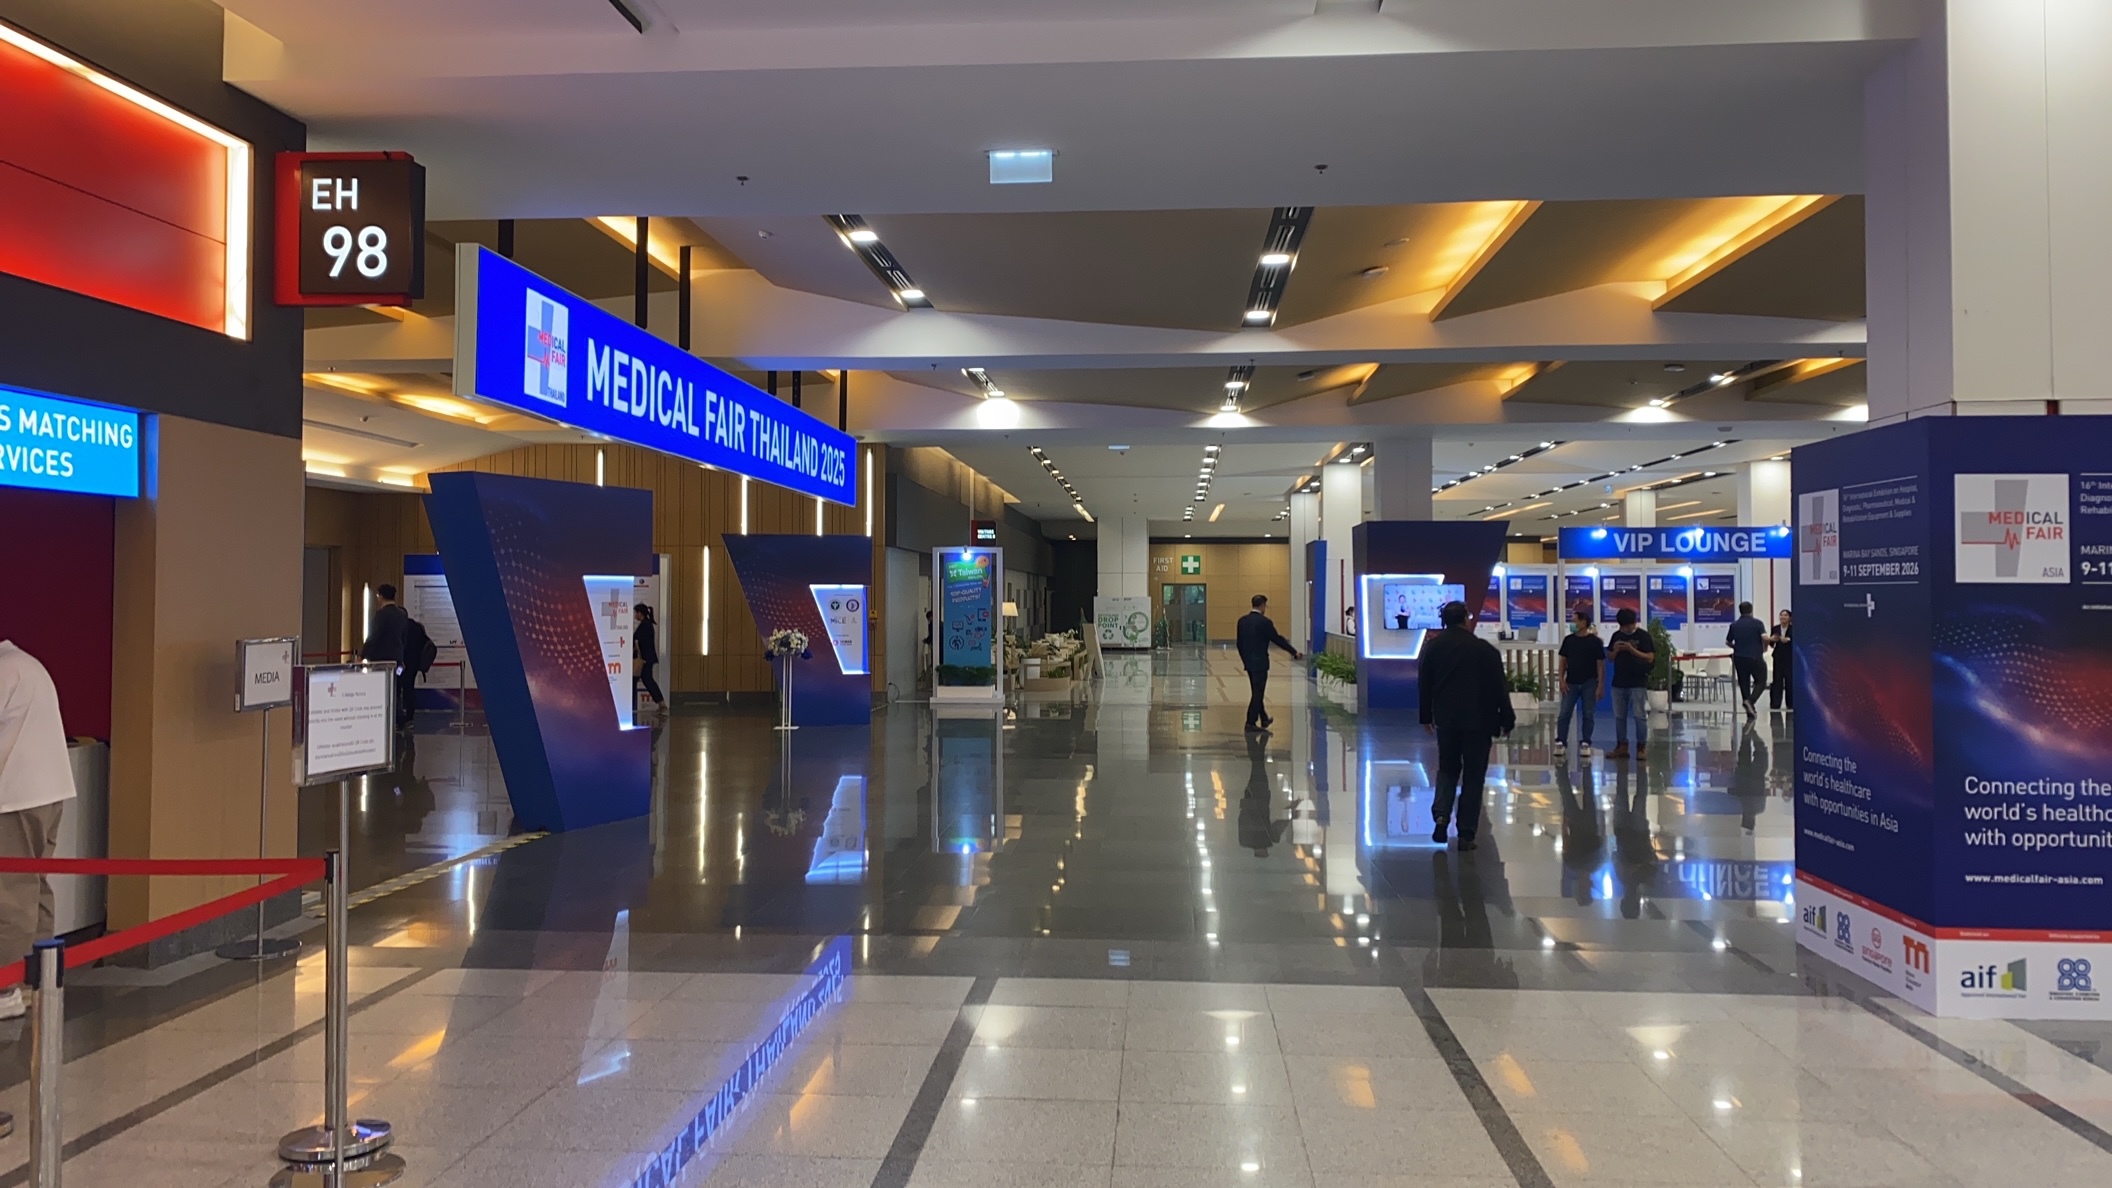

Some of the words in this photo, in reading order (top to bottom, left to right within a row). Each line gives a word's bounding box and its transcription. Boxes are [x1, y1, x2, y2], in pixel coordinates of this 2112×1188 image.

[312, 178, 358, 210] EH
[323, 225, 388, 278] 98
[538, 330, 566, 353] MEDICAL
[551, 350, 566, 367] FAIR
[587, 337, 700, 437] MEDICAL
[705, 389, 746, 453] FAIR
[749, 409, 819, 478] THAILAND
[820, 442, 846, 488] 2025
[19, 407, 133, 449] MATCHING
[1988, 511, 2064, 524] MEDICAL
[1614, 533, 1653, 552] VIP
[1661, 532, 1767, 553] LOUNGE
[1823, 535, 1837, 548] FAIR
[2026, 526, 2064, 540] FAIR
[1889, 545, 1919, 556] SINGAPORE
[1153, 557, 1174, 565] FIRST
[1843, 564, 1857, 577] 9-11
[1858, 562, 1901, 577] SEPTEMBER
[1901, 561, 1920, 576] 2026
[958, 567, 983, 577] Taiwan
[2042, 567, 2065, 578] ASIA
[254, 671, 280, 684] MEDIA
[1803, 746, 1843, 774] Connecting
[1844, 756, 1857, 774] the
[1803, 771, 1829, 789] world's
[1830, 775, 1871, 800] healthcare
[1965, 776, 2075, 800] Connecting
[2080, 778, 2112, 796] the
[1803, 790, 1819, 808] with
[1819, 797, 1869, 824] opportunities
[1870, 808, 1879, 826] in
[1879, 812, 1899, 833] Asia
[1964, 802, 2037, 821] world's
[1803, 828, 1855, 852] www.medicalfair-asia.com
[1964, 828, 2006, 846] with
[1964, 874, 2104, 885] www.medicalfair-asia.com
[1803, 905, 1816, 926] aif
[1960, 965, 1998, 989] aif
